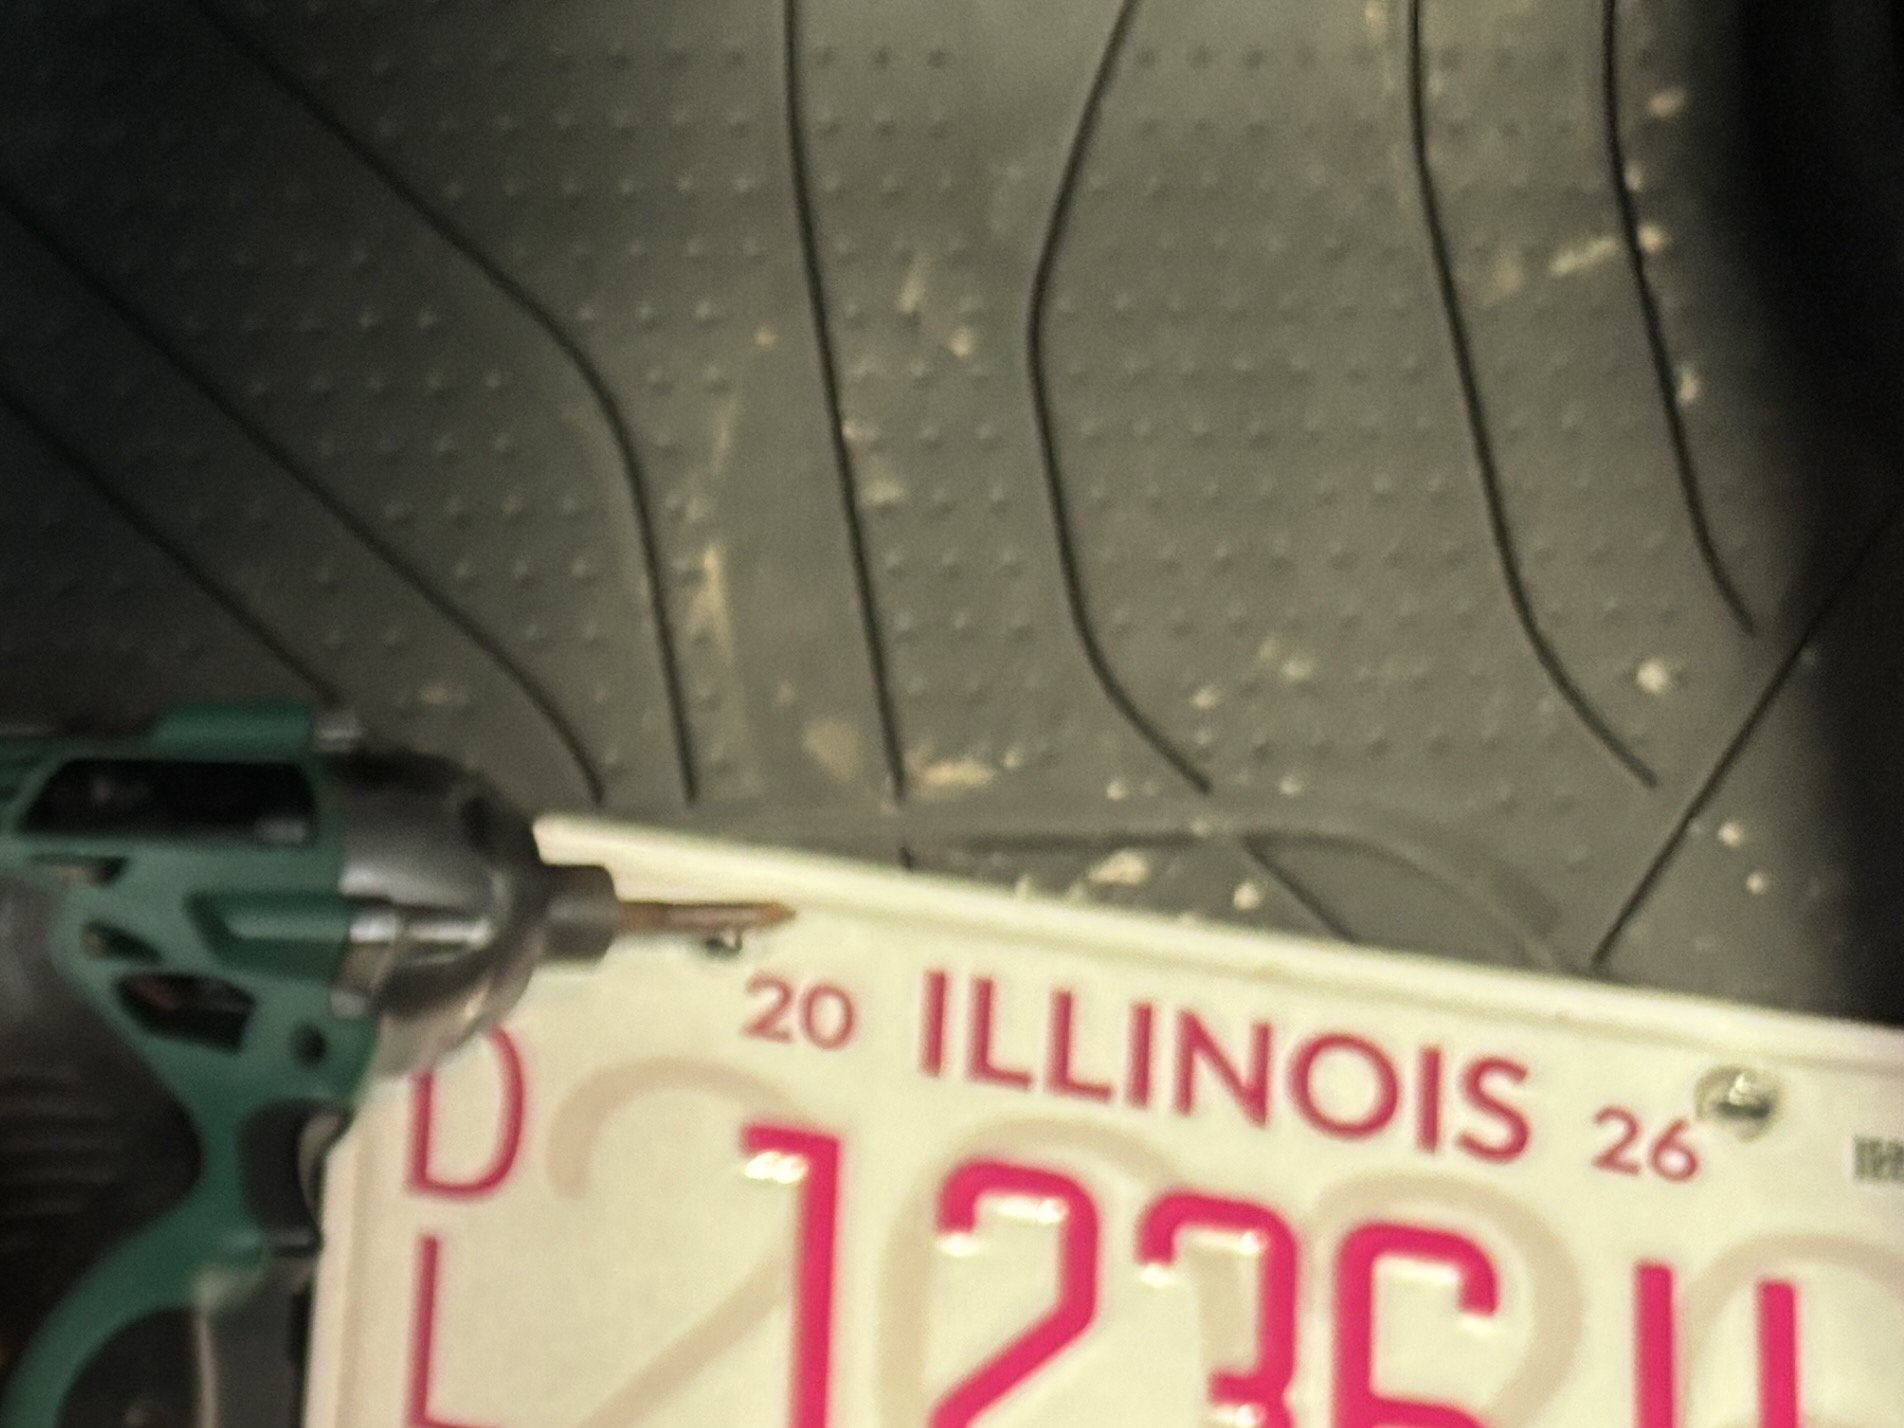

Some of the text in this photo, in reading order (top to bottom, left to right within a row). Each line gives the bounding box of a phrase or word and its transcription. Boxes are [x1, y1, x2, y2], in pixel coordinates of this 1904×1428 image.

[743, 974, 860, 1052] 20
[920, 971, 1532, 1165] ILLINOIS
[1593, 1105, 1703, 1185] 26
